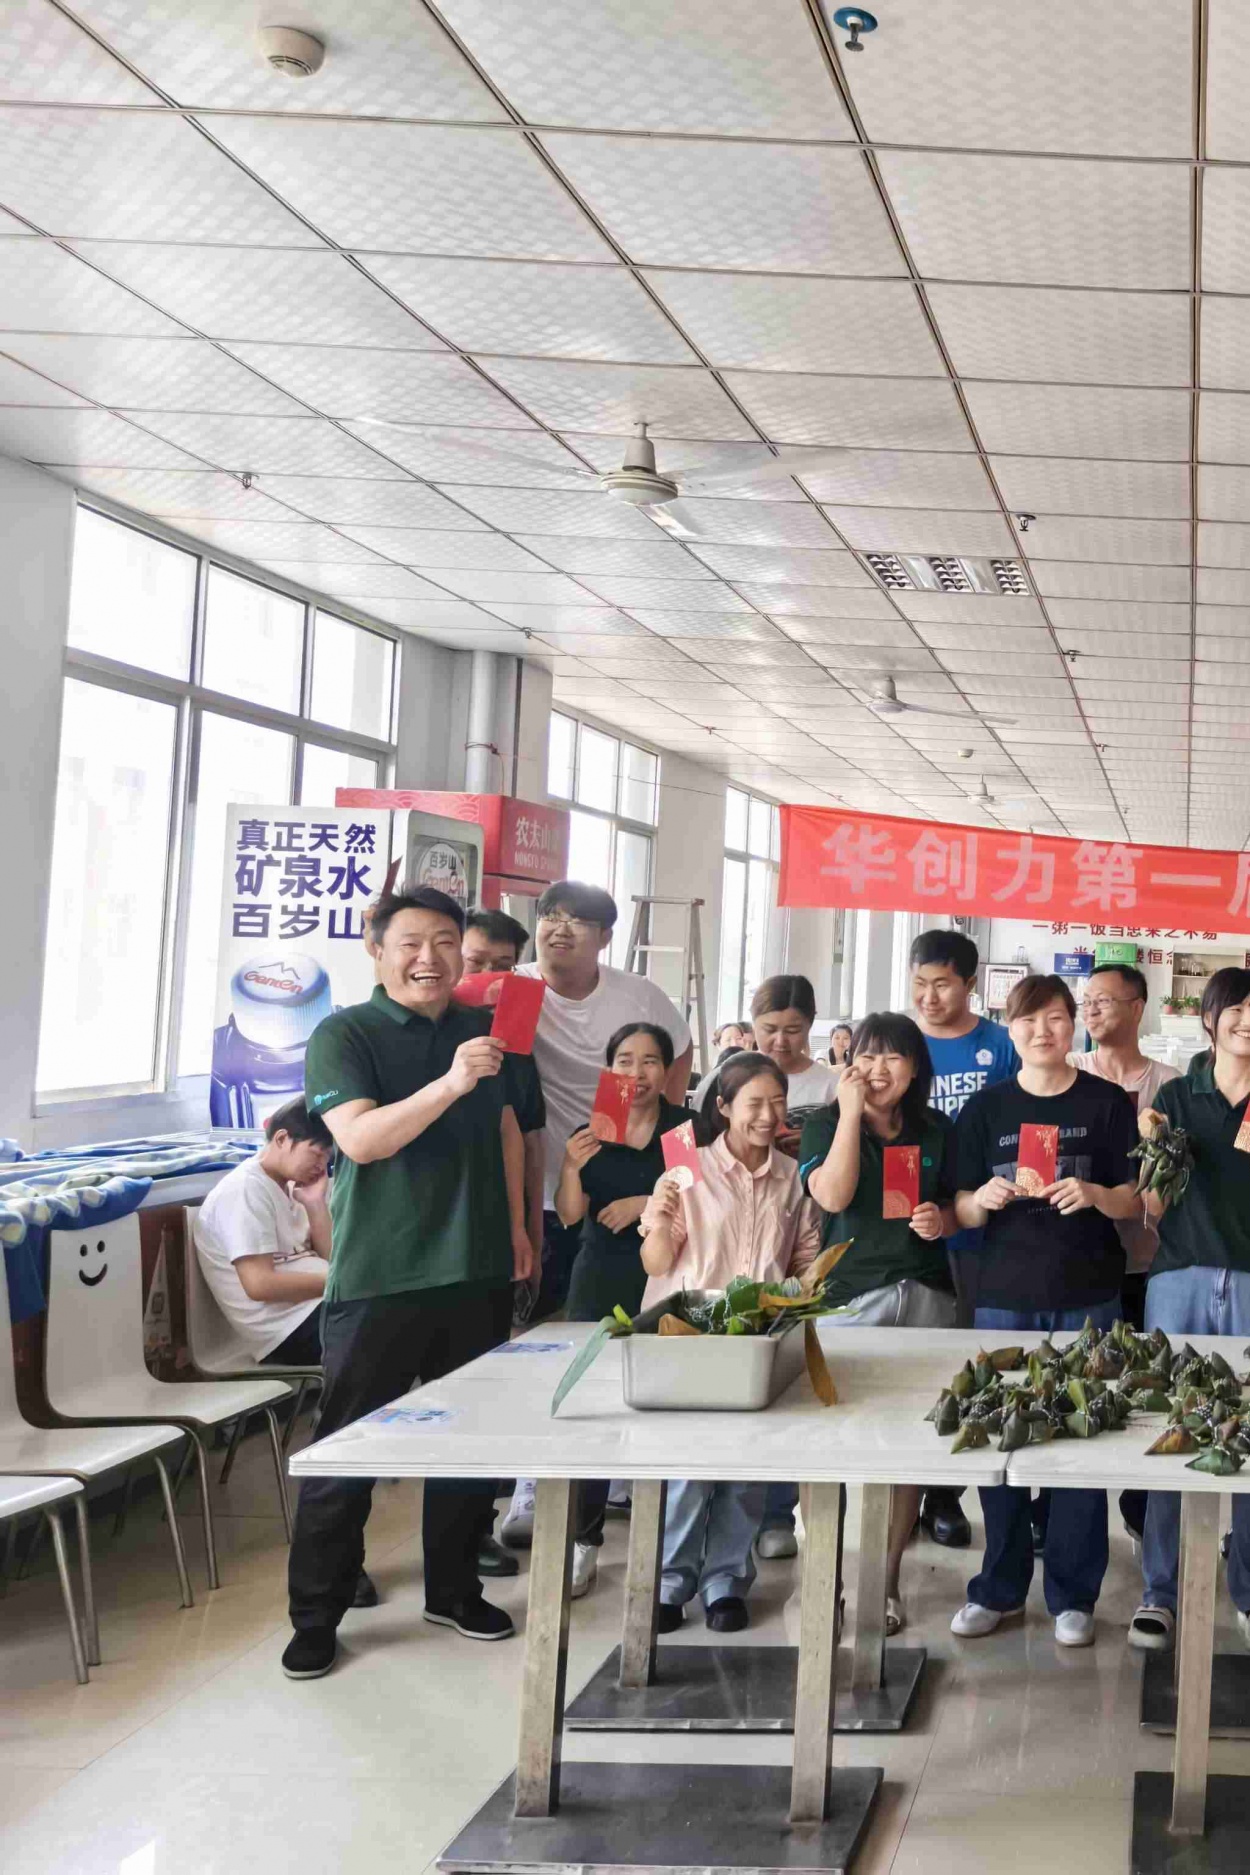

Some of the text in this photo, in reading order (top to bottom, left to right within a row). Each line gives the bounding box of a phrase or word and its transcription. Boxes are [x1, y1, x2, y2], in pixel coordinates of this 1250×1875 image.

[236, 819, 376, 854] 真正天然
[235, 854, 373, 900] 矿泉水
[430, 851, 457, 869] 百岁山
[232, 903, 365, 940] 百岁山
